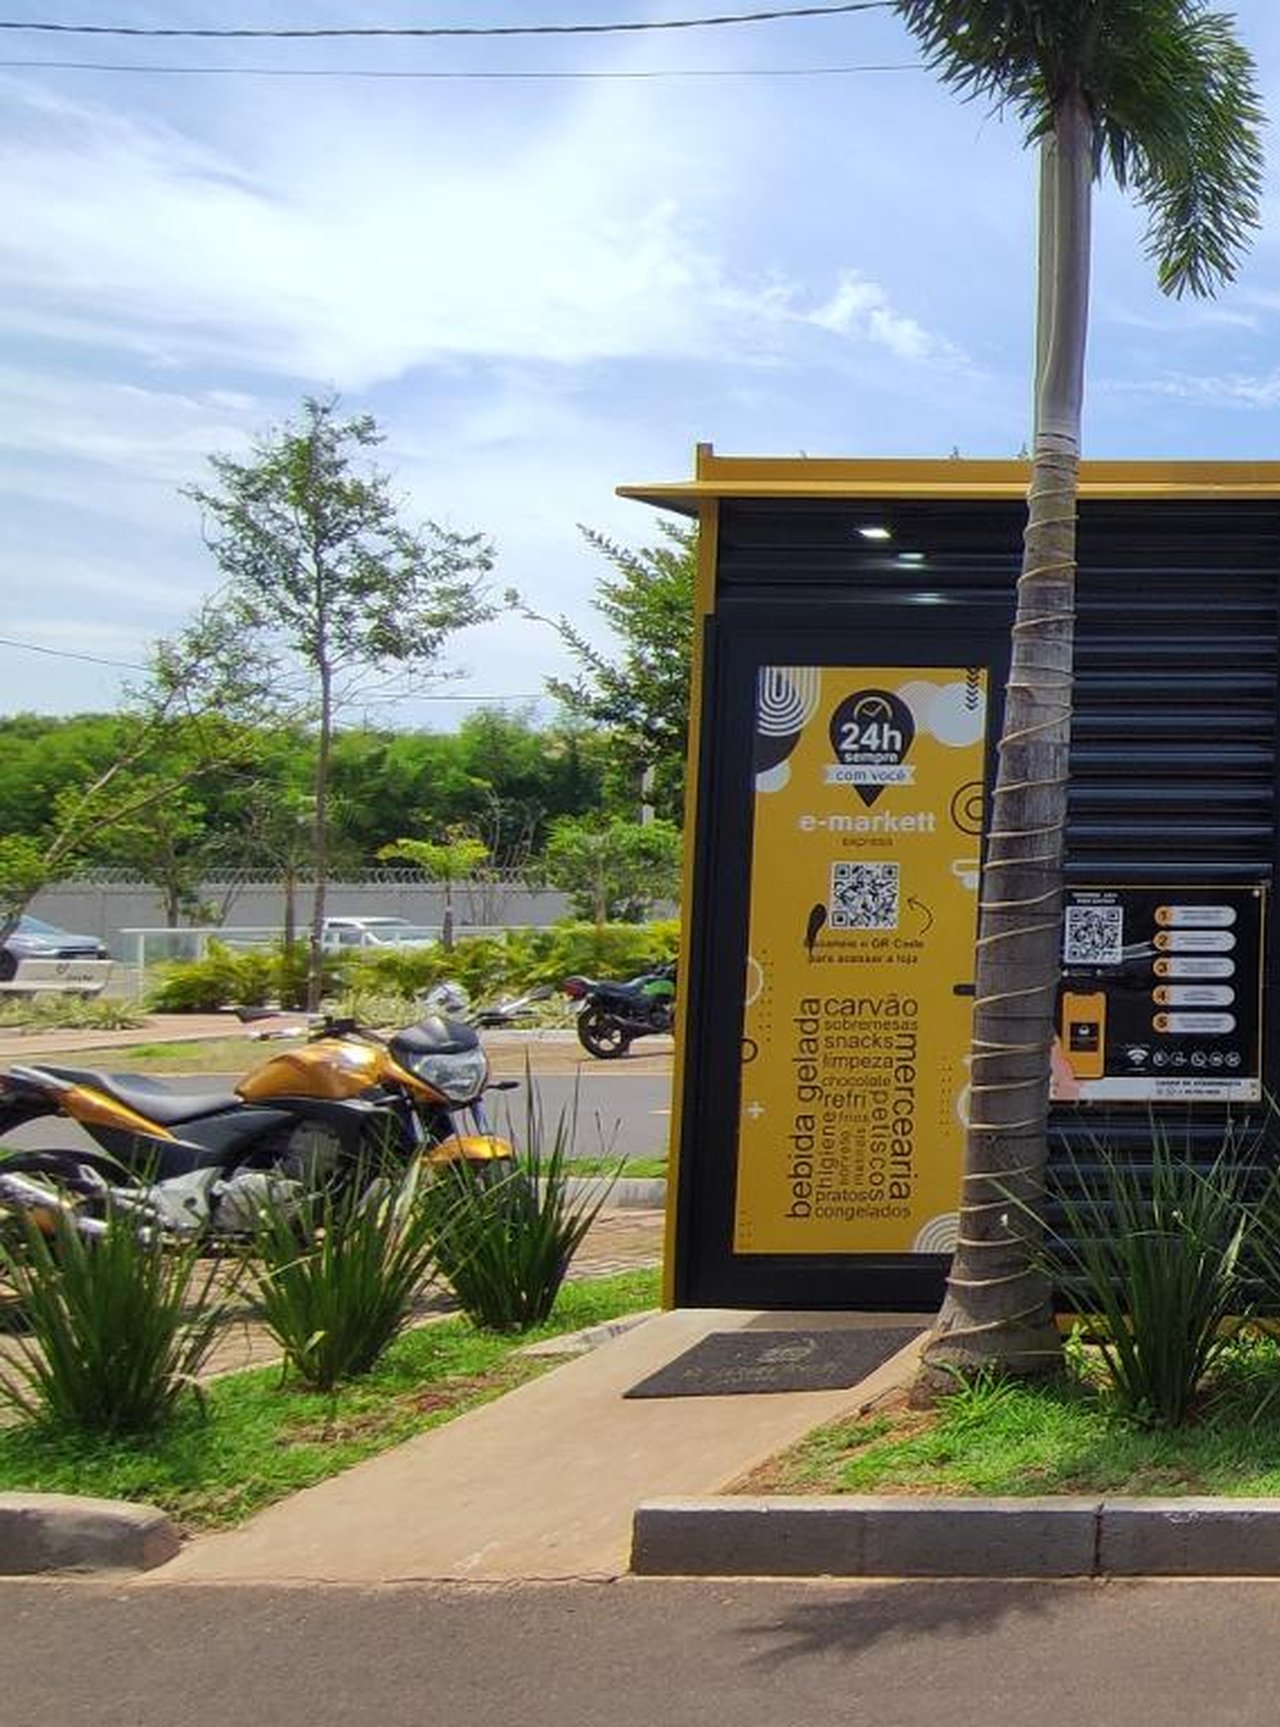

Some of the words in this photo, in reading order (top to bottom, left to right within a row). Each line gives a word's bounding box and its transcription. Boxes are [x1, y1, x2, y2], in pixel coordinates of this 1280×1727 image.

[840, 721, 902, 751] 24h
[844, 752, 899, 764] sempre
[836, 771, 866, 781] com
[799, 811, 936, 832] e-markett
[1158, 934, 1168, 946] 2
[1157, 961, 1168, 974] 3
[824, 994, 918, 1017] carvão
[824, 1019, 918, 1031] sobremesas
[1157, 1015, 1168, 1028] 5
[793, 998, 823, 1101] gelada
[824, 1034, 894, 1049] snacks
[823, 1053, 893, 1070] limpeza
[822, 1075, 891, 1087] chocolate
[825, 1089, 866, 1109] refri
[889, 1033, 918, 1200] mercearia
[816, 1111, 840, 1188] higiene
[868, 1090, 890, 1201] petiscos
[784, 1114, 816, 1217] bebida
[816, 1189, 868, 1203] pratos
[815, 1206, 911, 1221] congelados
